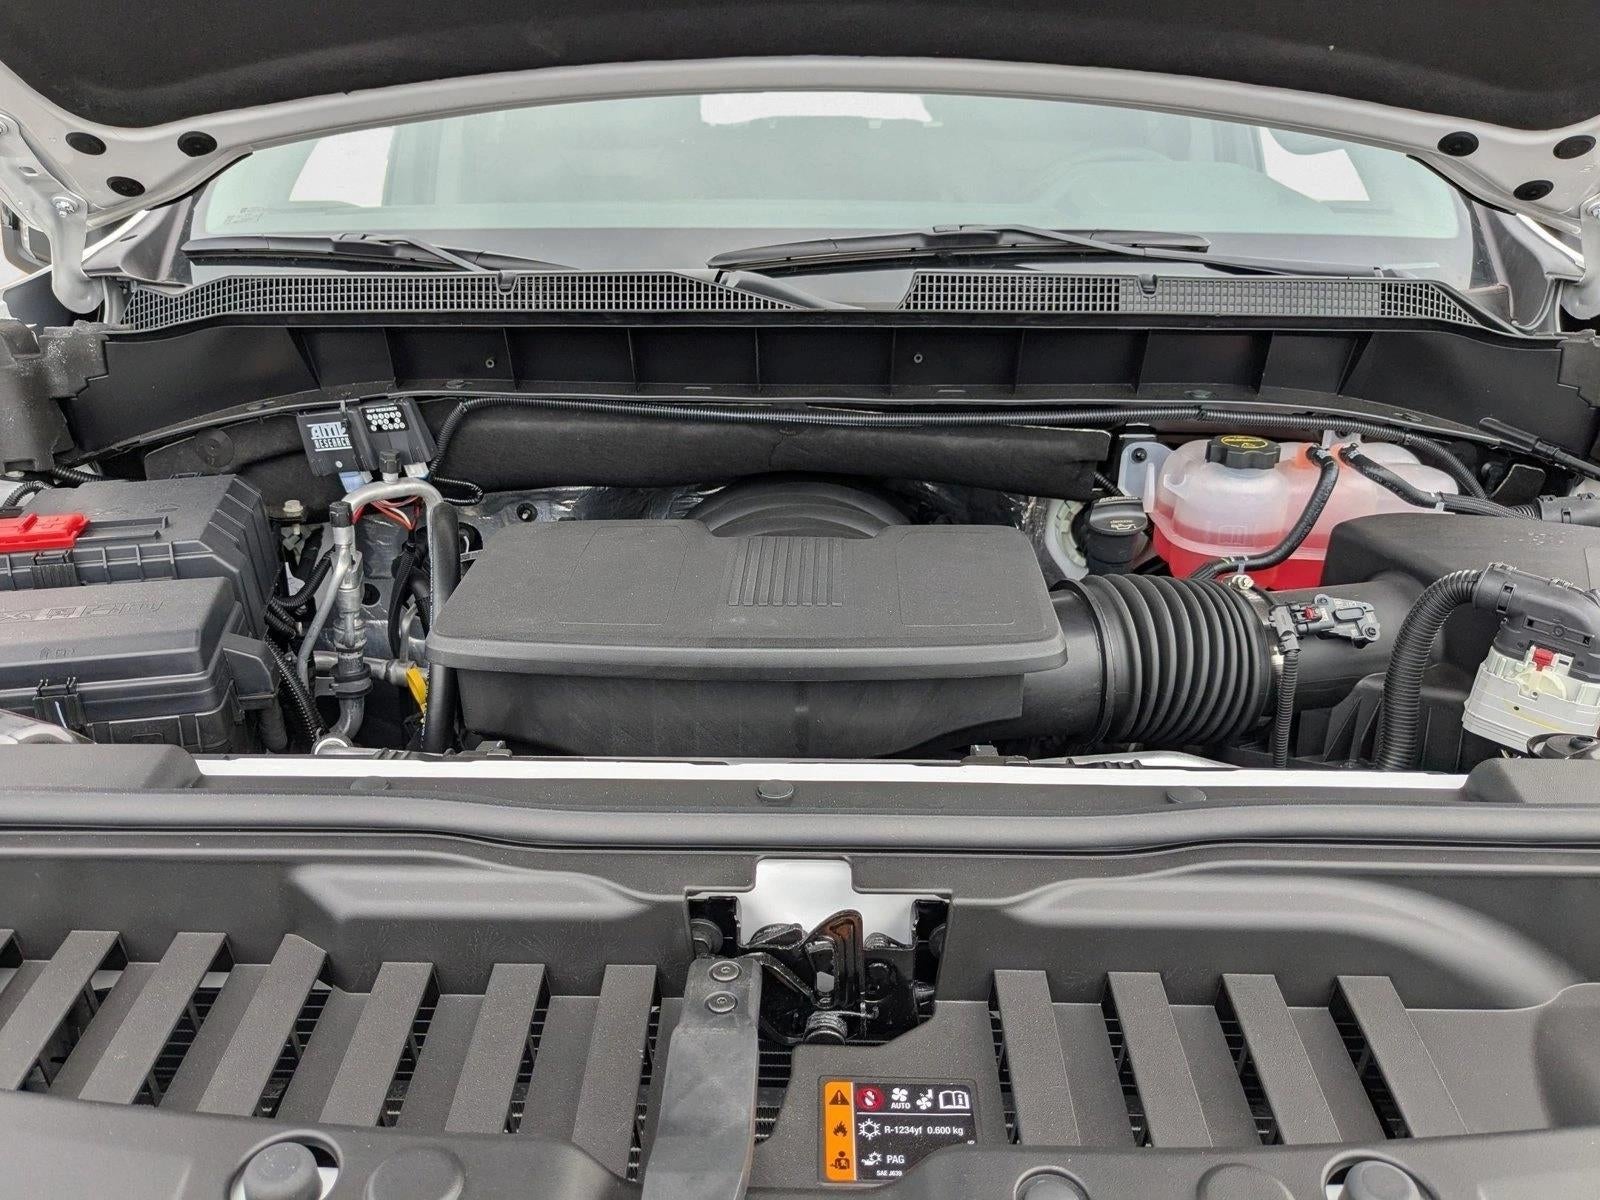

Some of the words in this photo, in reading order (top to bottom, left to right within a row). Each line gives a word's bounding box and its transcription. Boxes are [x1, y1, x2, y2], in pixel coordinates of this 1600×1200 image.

[314, 437, 351, 449] RESEARCH
[884, 1125, 922, 1136] R-1234yf
[927, 1126, 951, 1134] 0.600
[952, 1126, 964, 1136] kg
[886, 1155, 905, 1164] PAG
